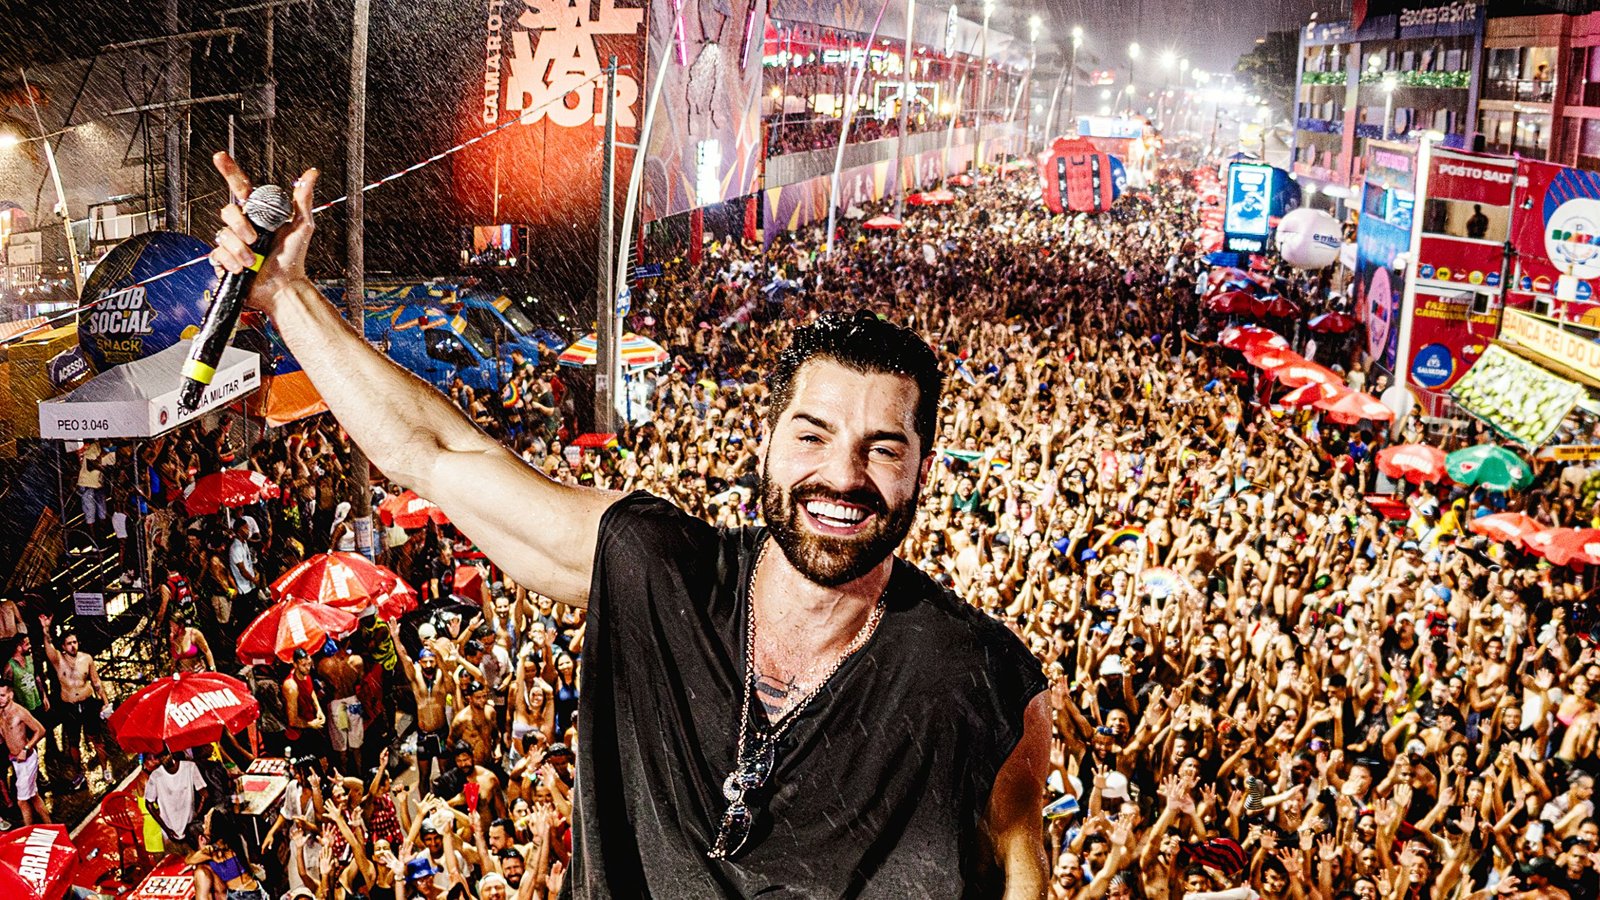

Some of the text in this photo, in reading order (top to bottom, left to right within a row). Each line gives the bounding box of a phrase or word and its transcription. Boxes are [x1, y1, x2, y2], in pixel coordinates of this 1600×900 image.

[1439, 164, 1482, 179] POSTO
[96, 337, 142, 352] SNACK
[1502, 310, 1540, 340] BANCA
[1567, 338, 1585, 362] DO
[210, 379, 239, 403] MILITAR
[57, 419, 109, 430] PEO 3.046
[168, 687, 242, 729] BRAHMA
